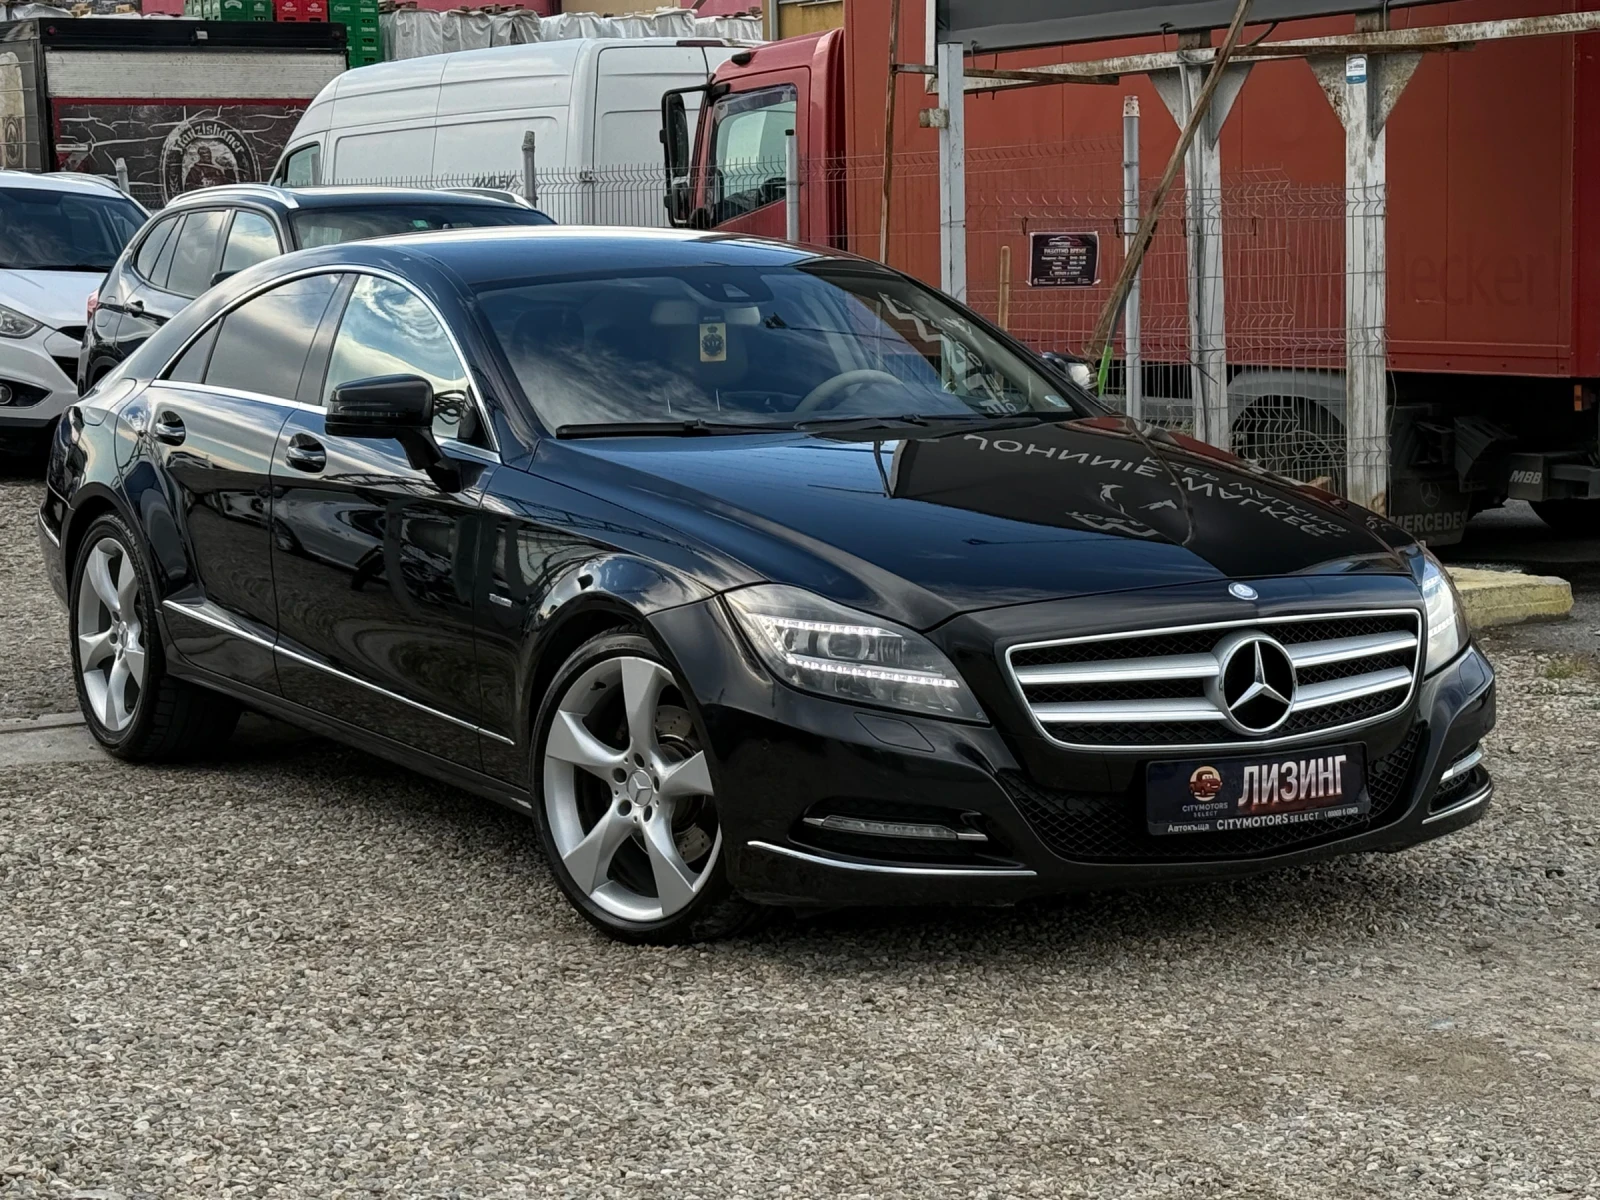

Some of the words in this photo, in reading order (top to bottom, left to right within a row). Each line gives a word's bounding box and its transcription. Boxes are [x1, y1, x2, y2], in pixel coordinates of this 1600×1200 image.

[1509, 469, 1542, 485] MBB
[1237, 754, 1347, 807] ЛИЗИНГ
[1182, 802, 1229, 813] CITYMOTORS
[1167, 822, 1210, 833] Автокъща
[1216, 813, 1289, 831] CITYMOTORS
[1289, 812, 1320, 823] SELECT
